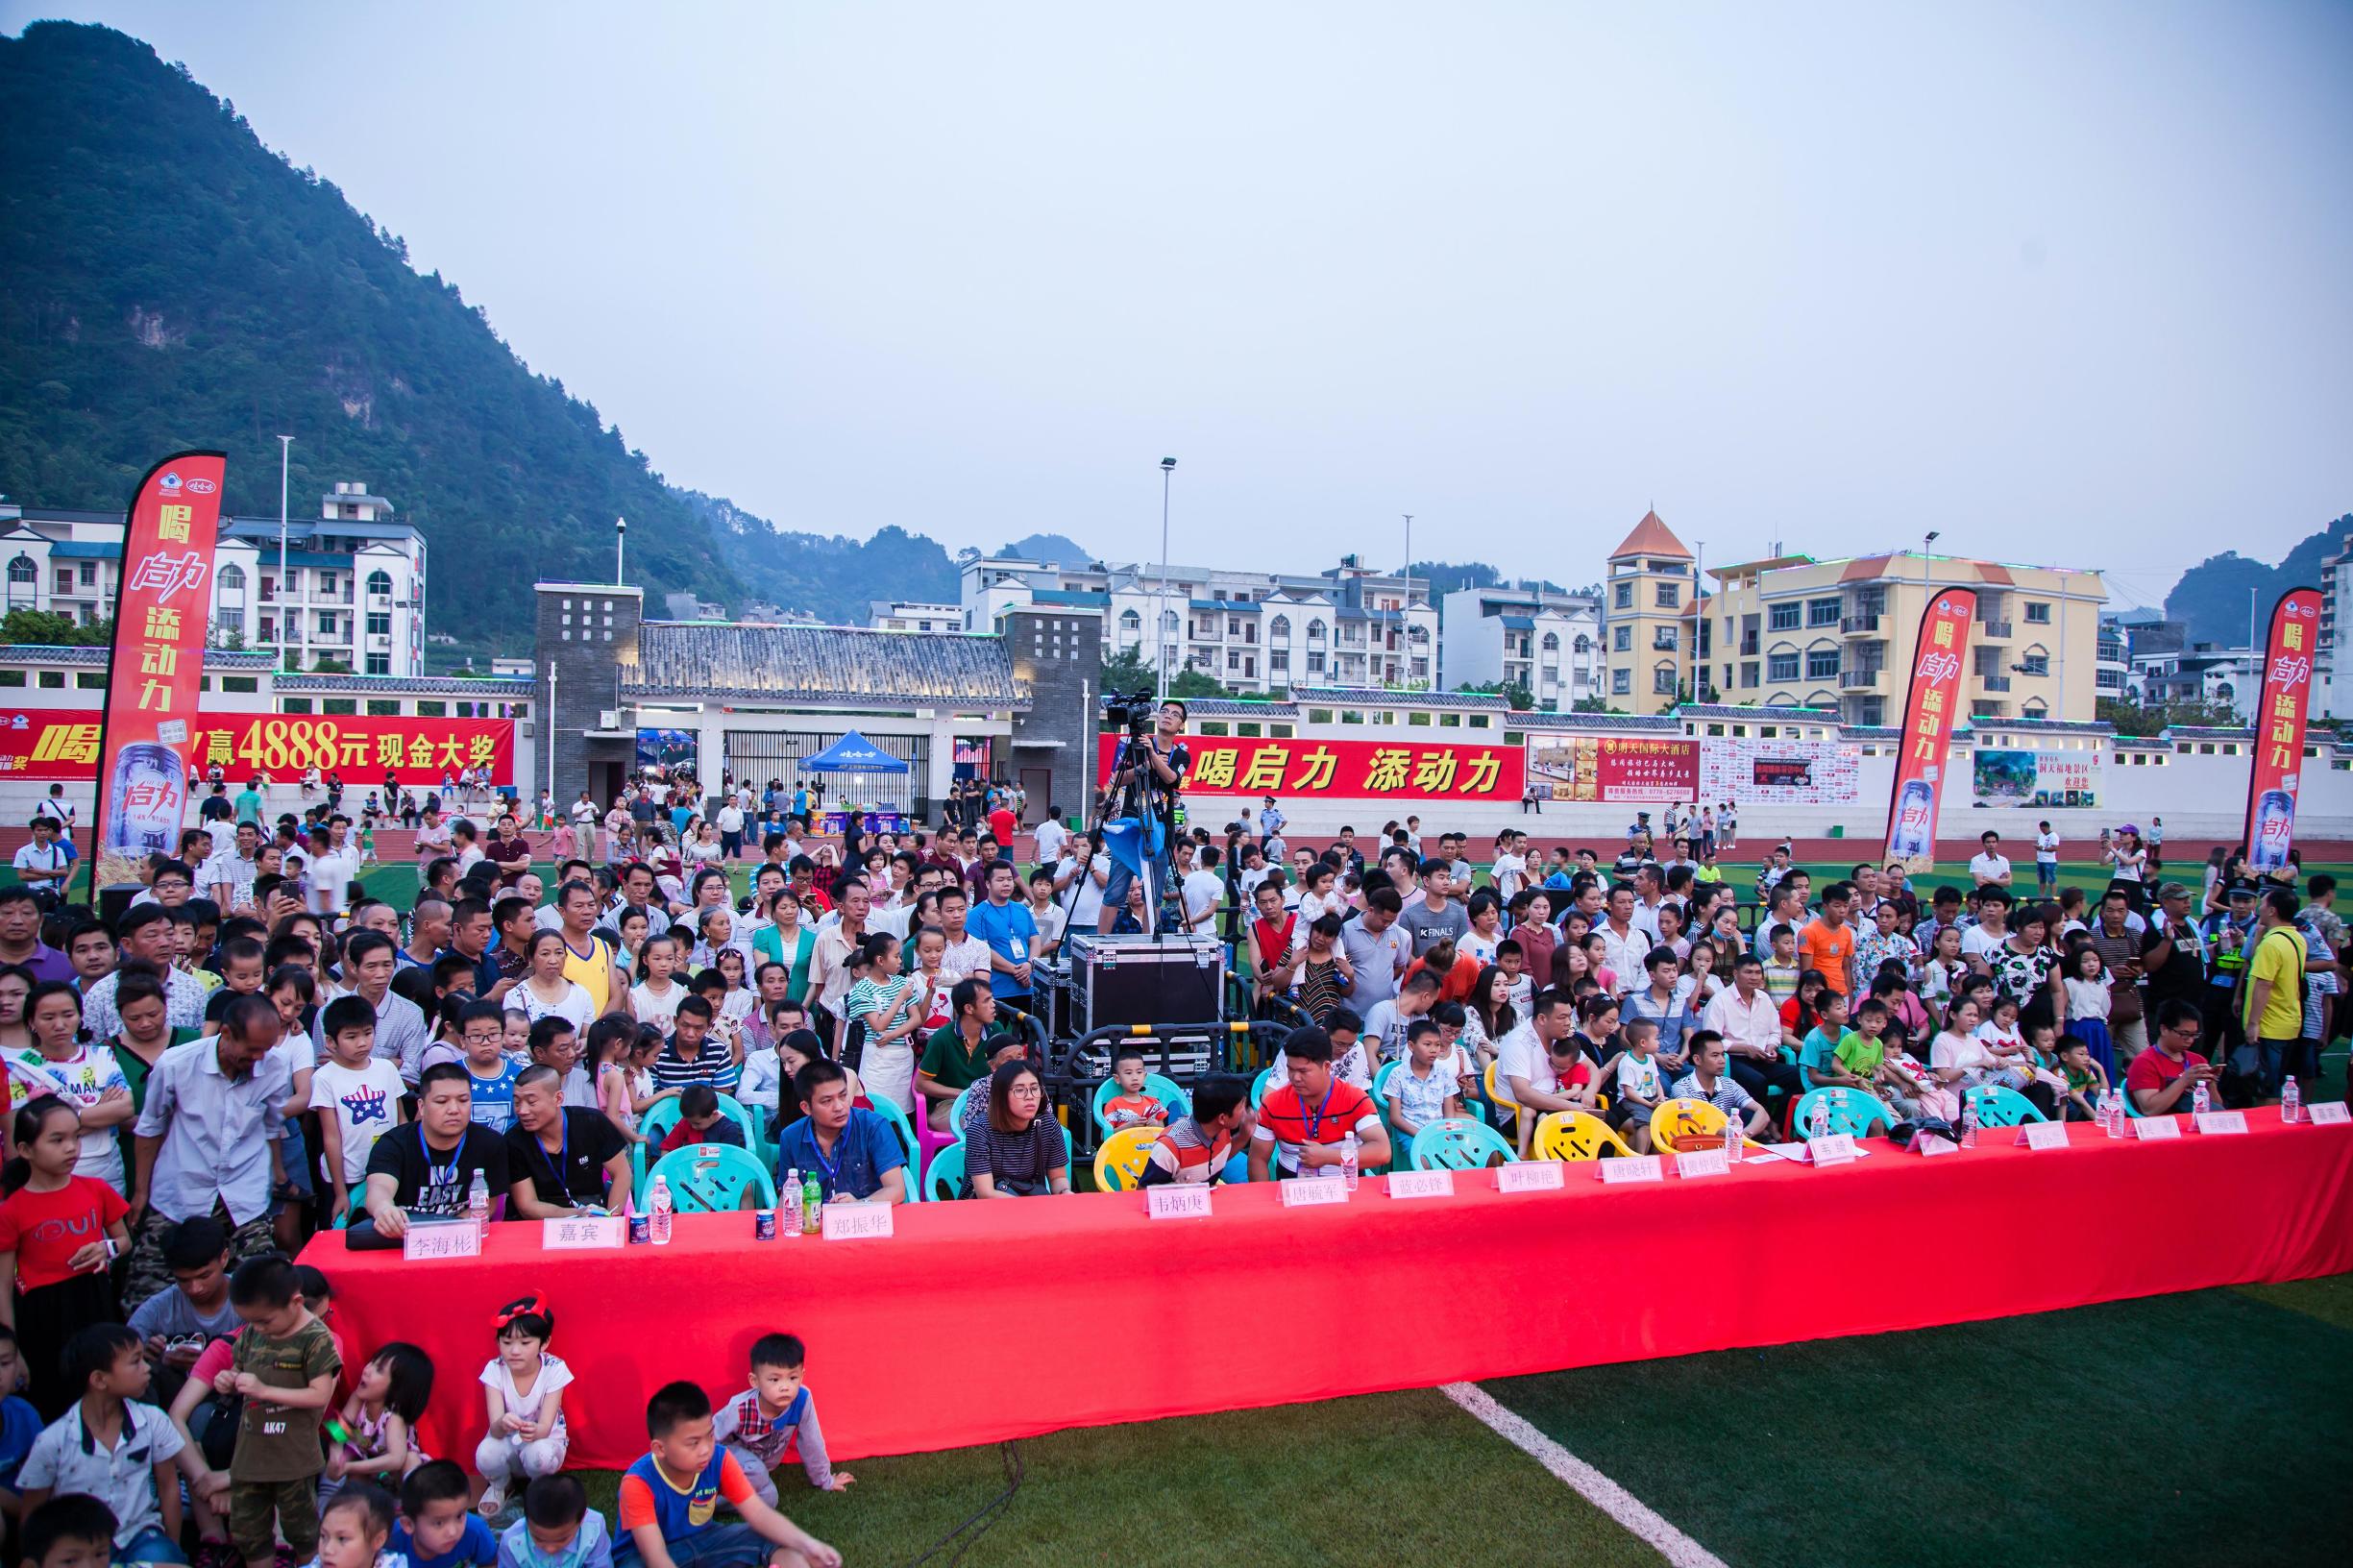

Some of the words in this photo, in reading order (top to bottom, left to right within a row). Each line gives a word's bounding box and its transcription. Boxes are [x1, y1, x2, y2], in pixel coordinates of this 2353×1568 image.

[1618, 742, 1690, 756] 明天国际大酒店
[1193, 744, 1337, 791] 喝启力
[1362, 747, 1502, 794] 添动力
[1428, 927, 1454, 937] FINALS
[429, 1165, 459, 1186] NO
[418, 1184, 463, 1207] EASY
[559, 1223, 600, 1242] 嘉宾
[833, 1213, 888, 1236] 郑振华
[413, 1235, 472, 1256] 李海彬
[263, 1422, 286, 1433] AK47
